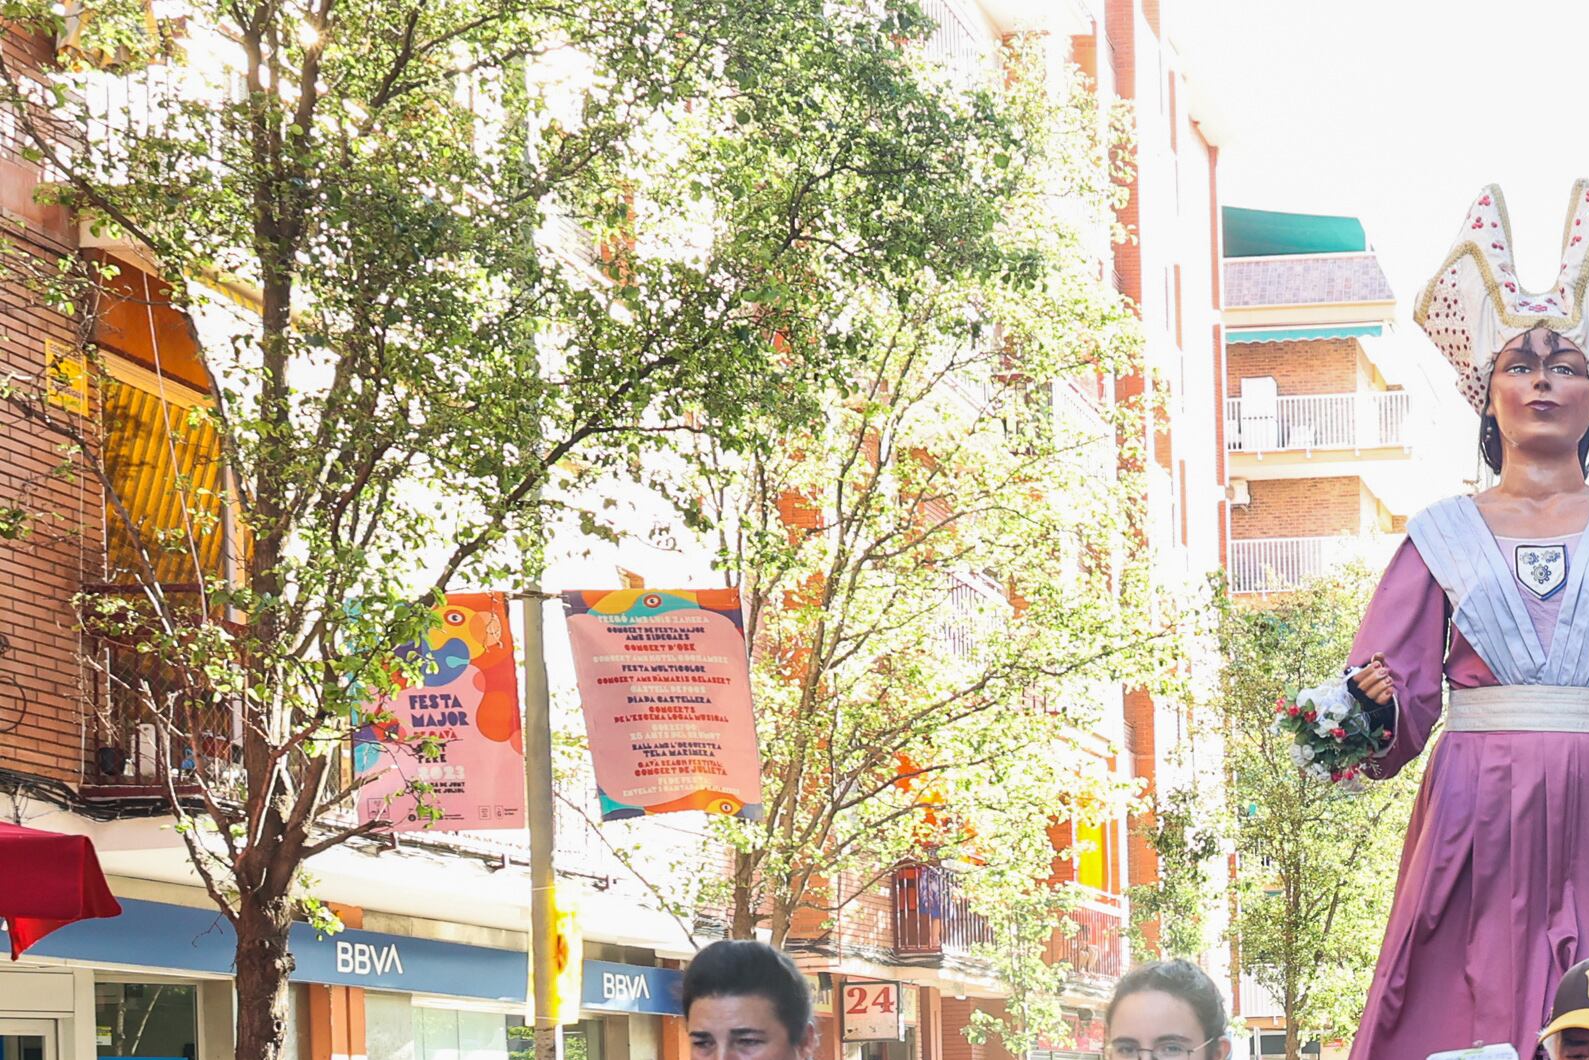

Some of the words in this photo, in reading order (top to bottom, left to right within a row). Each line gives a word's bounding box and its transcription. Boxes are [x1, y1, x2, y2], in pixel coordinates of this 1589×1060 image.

[409, 694, 463, 709] FESTA
[411, 711, 470, 727] MAJOR
[337, 941, 403, 976] BBVA
[603, 972, 650, 1000] BBVA
[846, 986, 894, 1014] 24
